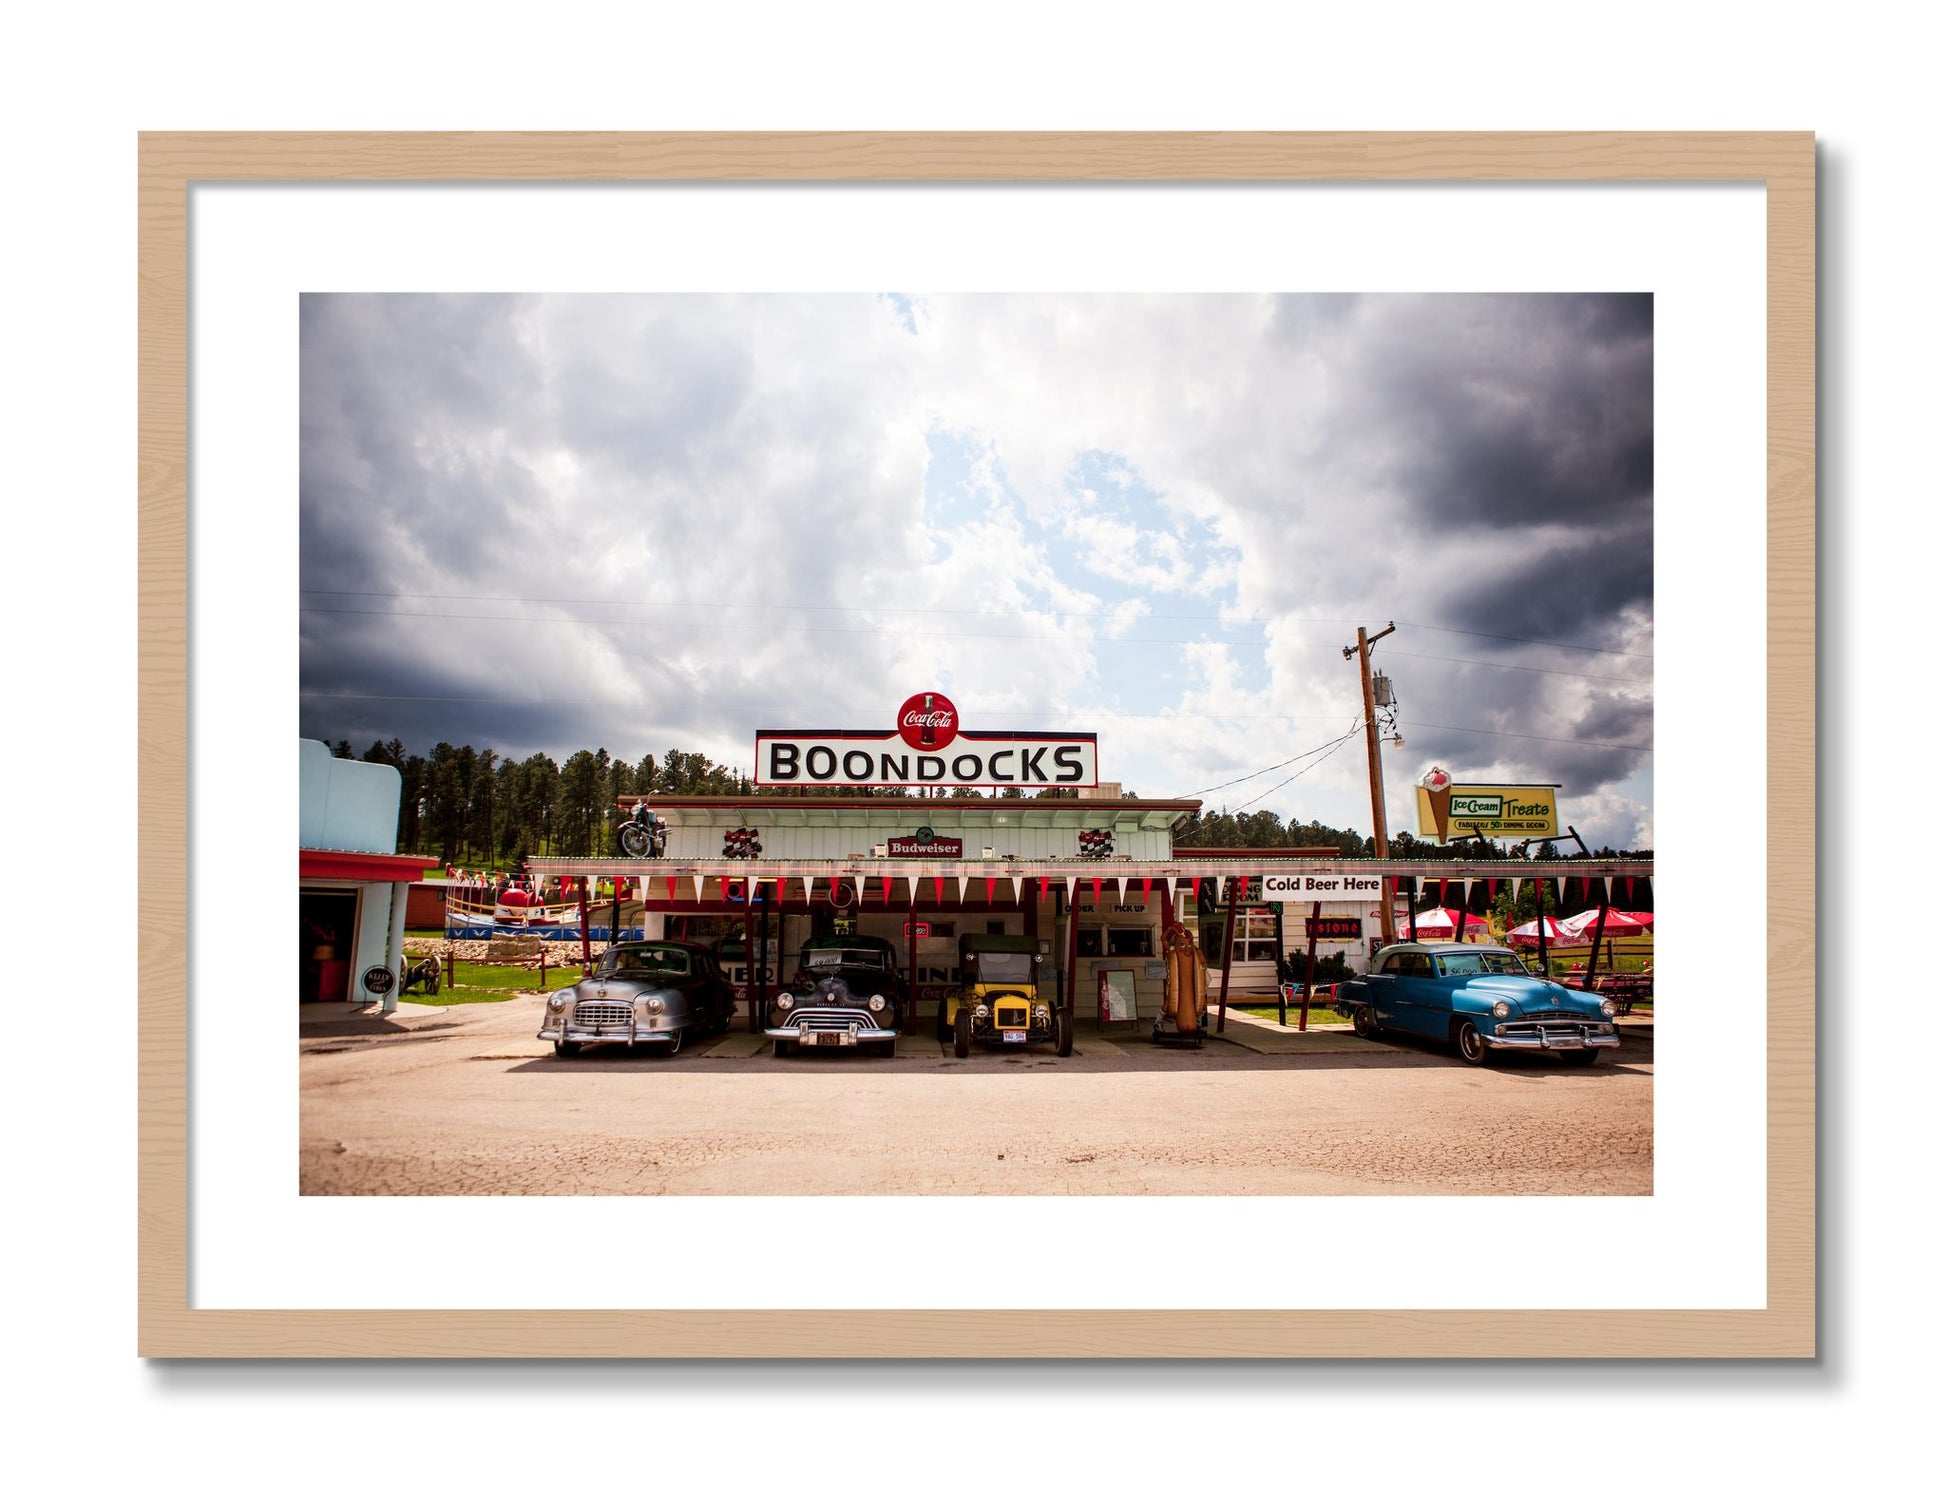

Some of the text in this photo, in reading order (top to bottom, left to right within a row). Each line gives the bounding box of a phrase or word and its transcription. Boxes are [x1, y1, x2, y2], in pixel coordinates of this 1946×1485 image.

[903, 710, 953, 727] Coca-Cola
[770, 743, 1084, 782] BOONDOCKS
[1453, 799, 1549, 817] Ice Cream Treats
[891, 843, 959, 853] Budweiser
[1266, 877, 1380, 891] Cold Beer Here
